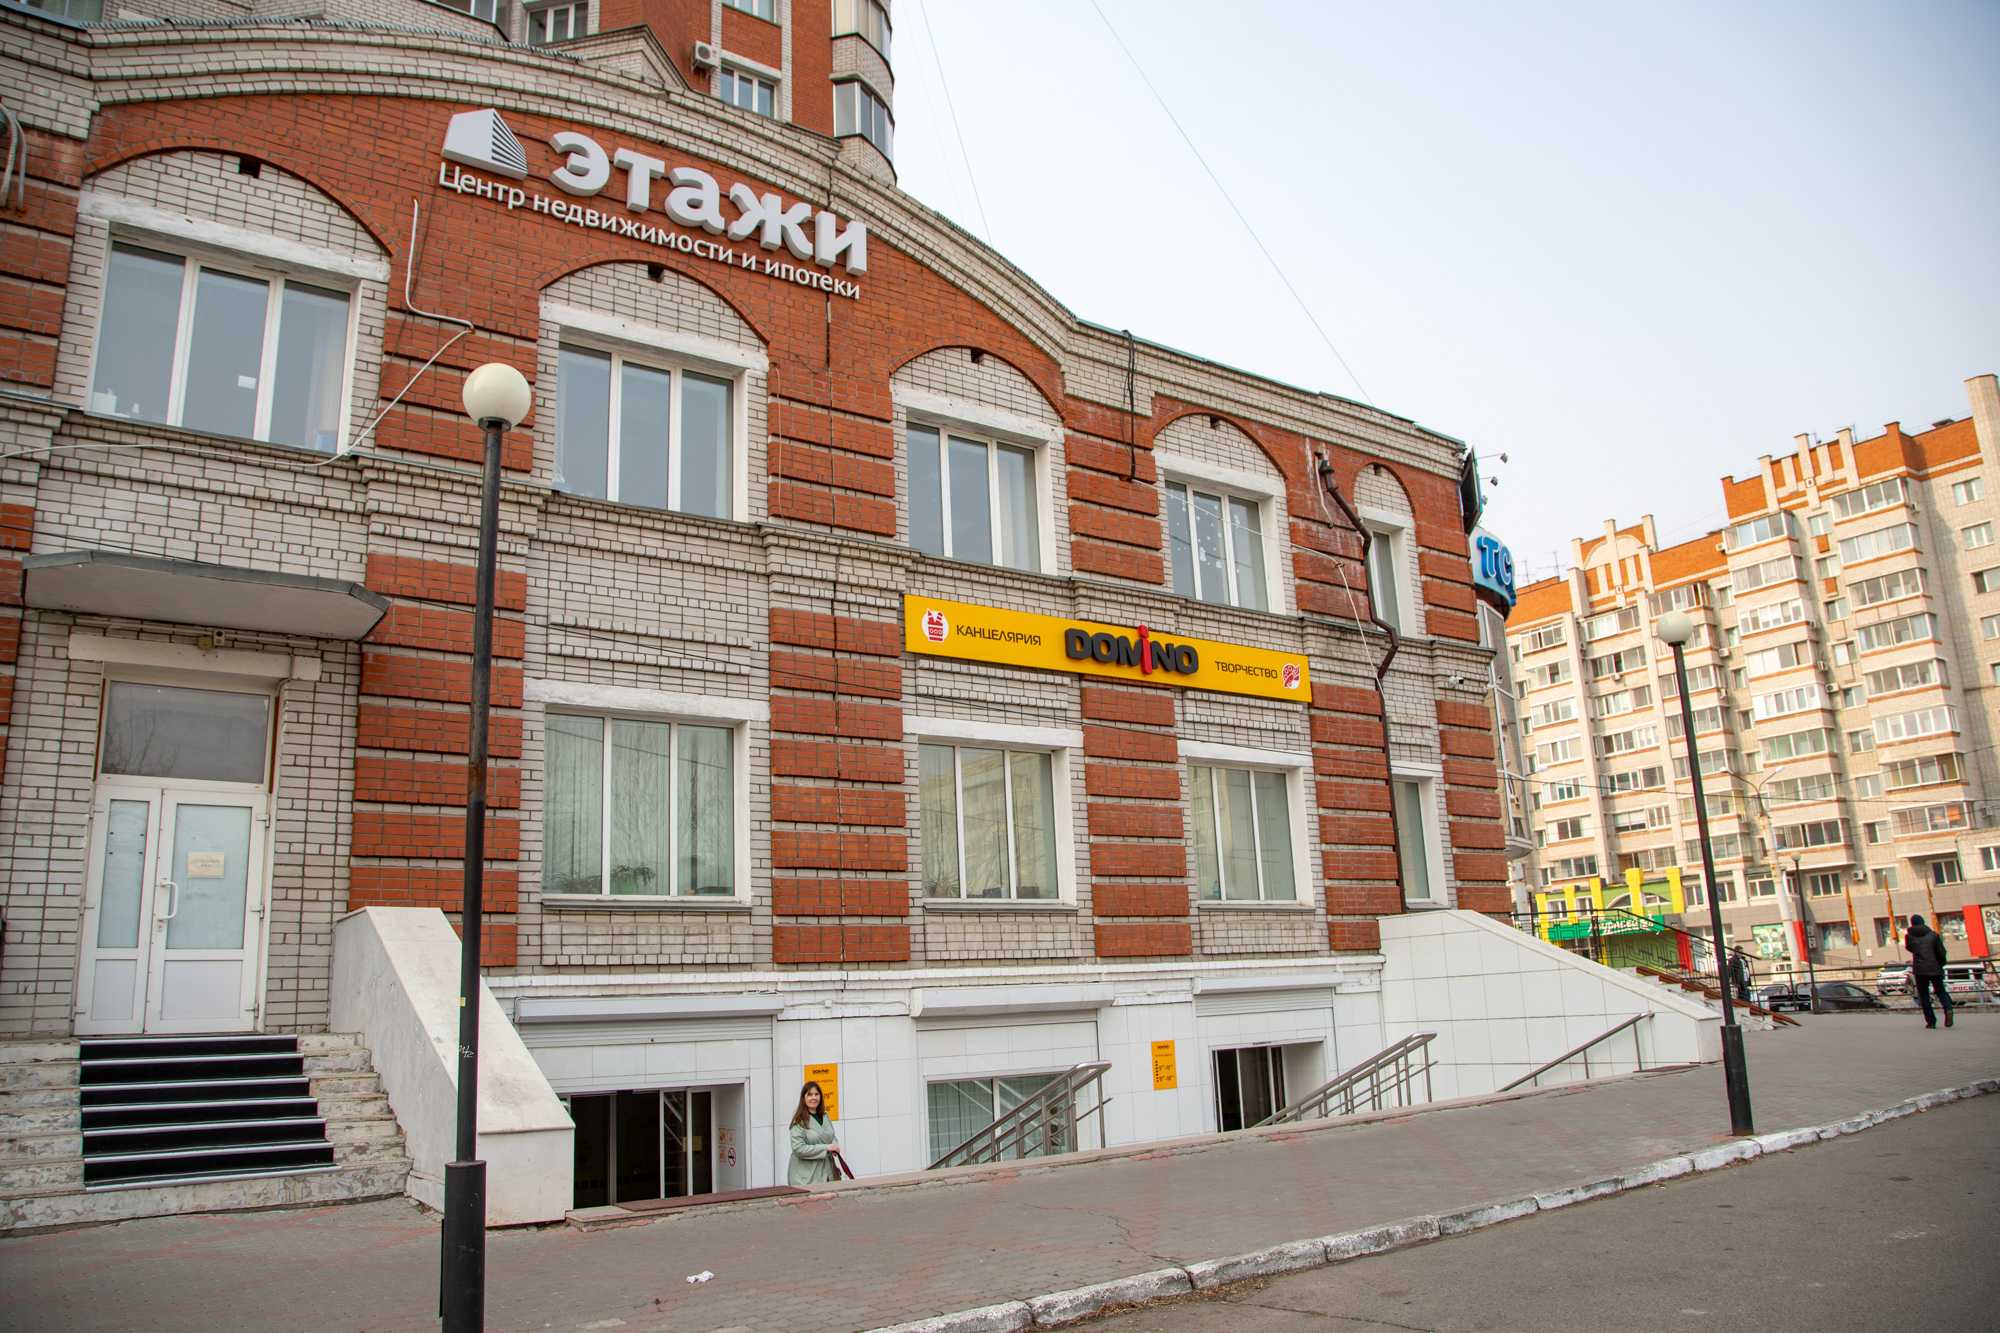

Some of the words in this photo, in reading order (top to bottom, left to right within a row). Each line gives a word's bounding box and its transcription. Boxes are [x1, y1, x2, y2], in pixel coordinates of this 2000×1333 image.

[439, 162, 525, 210] Центр
[533, 191, 732, 266] недвижимости
[742, 251, 756, 271] и
[765, 258, 860, 300] ипотеки
[956, 624, 1041, 646] КАНЦЕЛЯРИЯ
[1215, 661, 1278, 679] ТВОРЧЕСТВО
